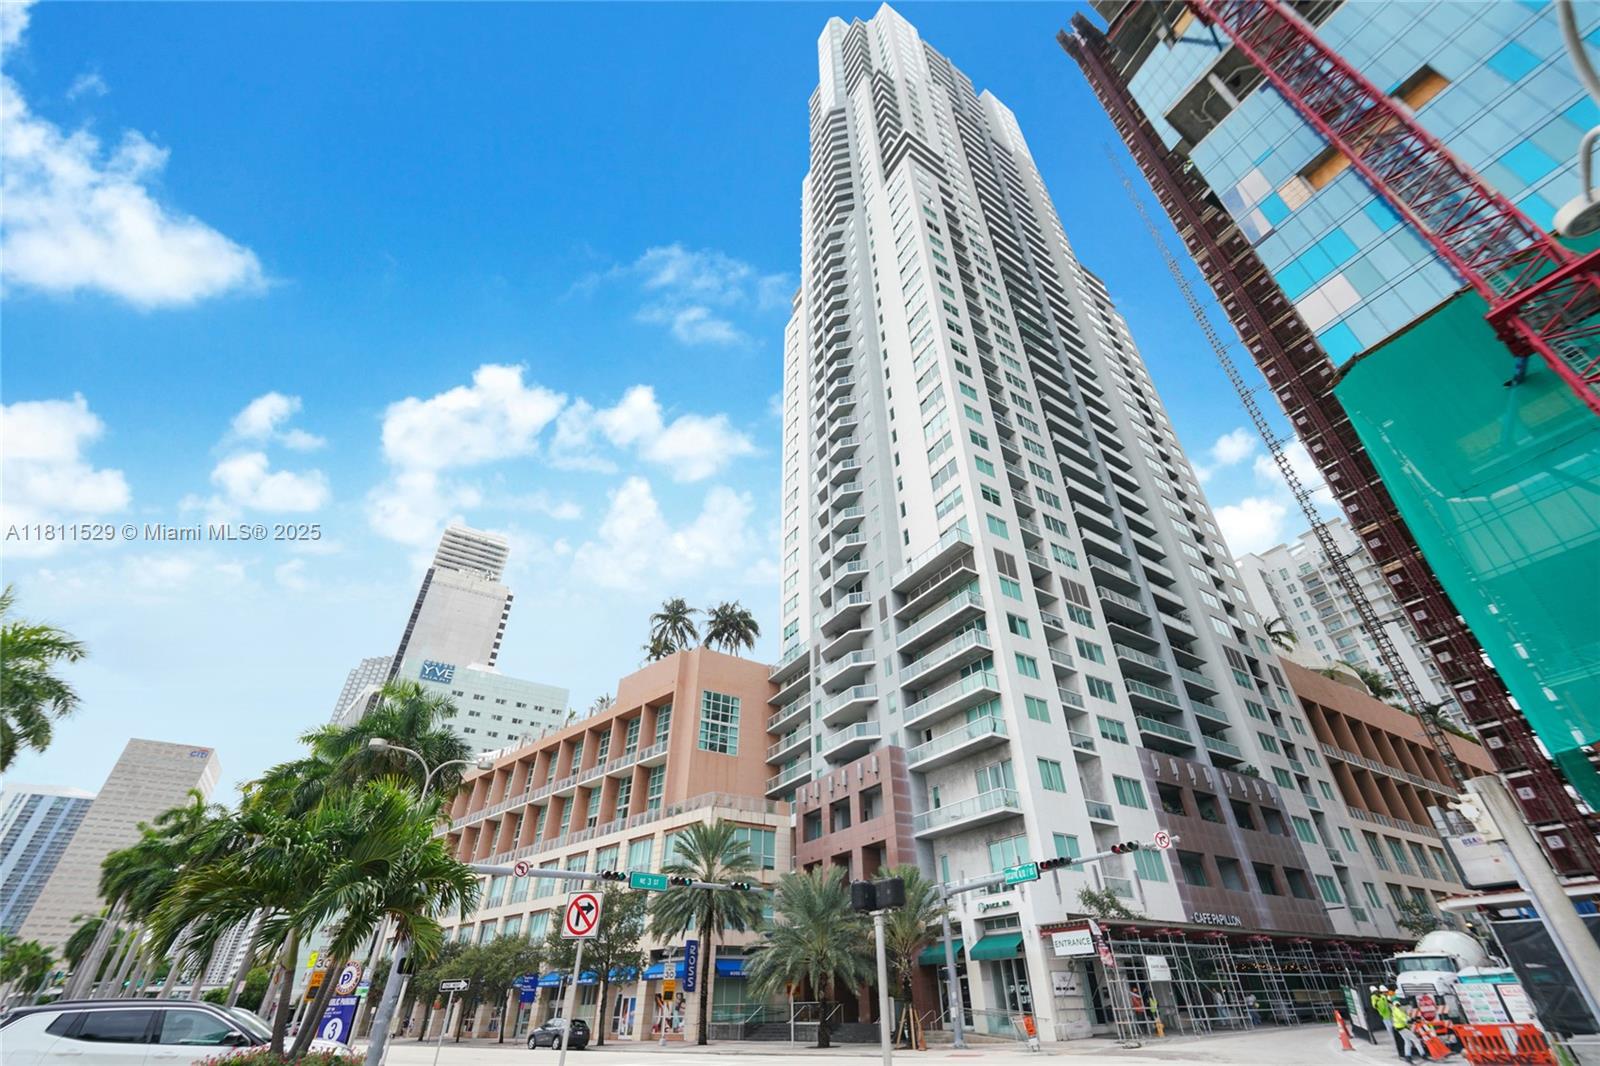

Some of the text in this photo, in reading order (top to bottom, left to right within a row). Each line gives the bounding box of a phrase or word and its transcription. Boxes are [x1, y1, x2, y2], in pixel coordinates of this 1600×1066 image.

[424, 664, 455, 678] YVE
[1054, 937, 1092, 949] ENTRANCE
[687, 944, 697, 988] ROSS
[327, 1021, 338, 1040] 3
